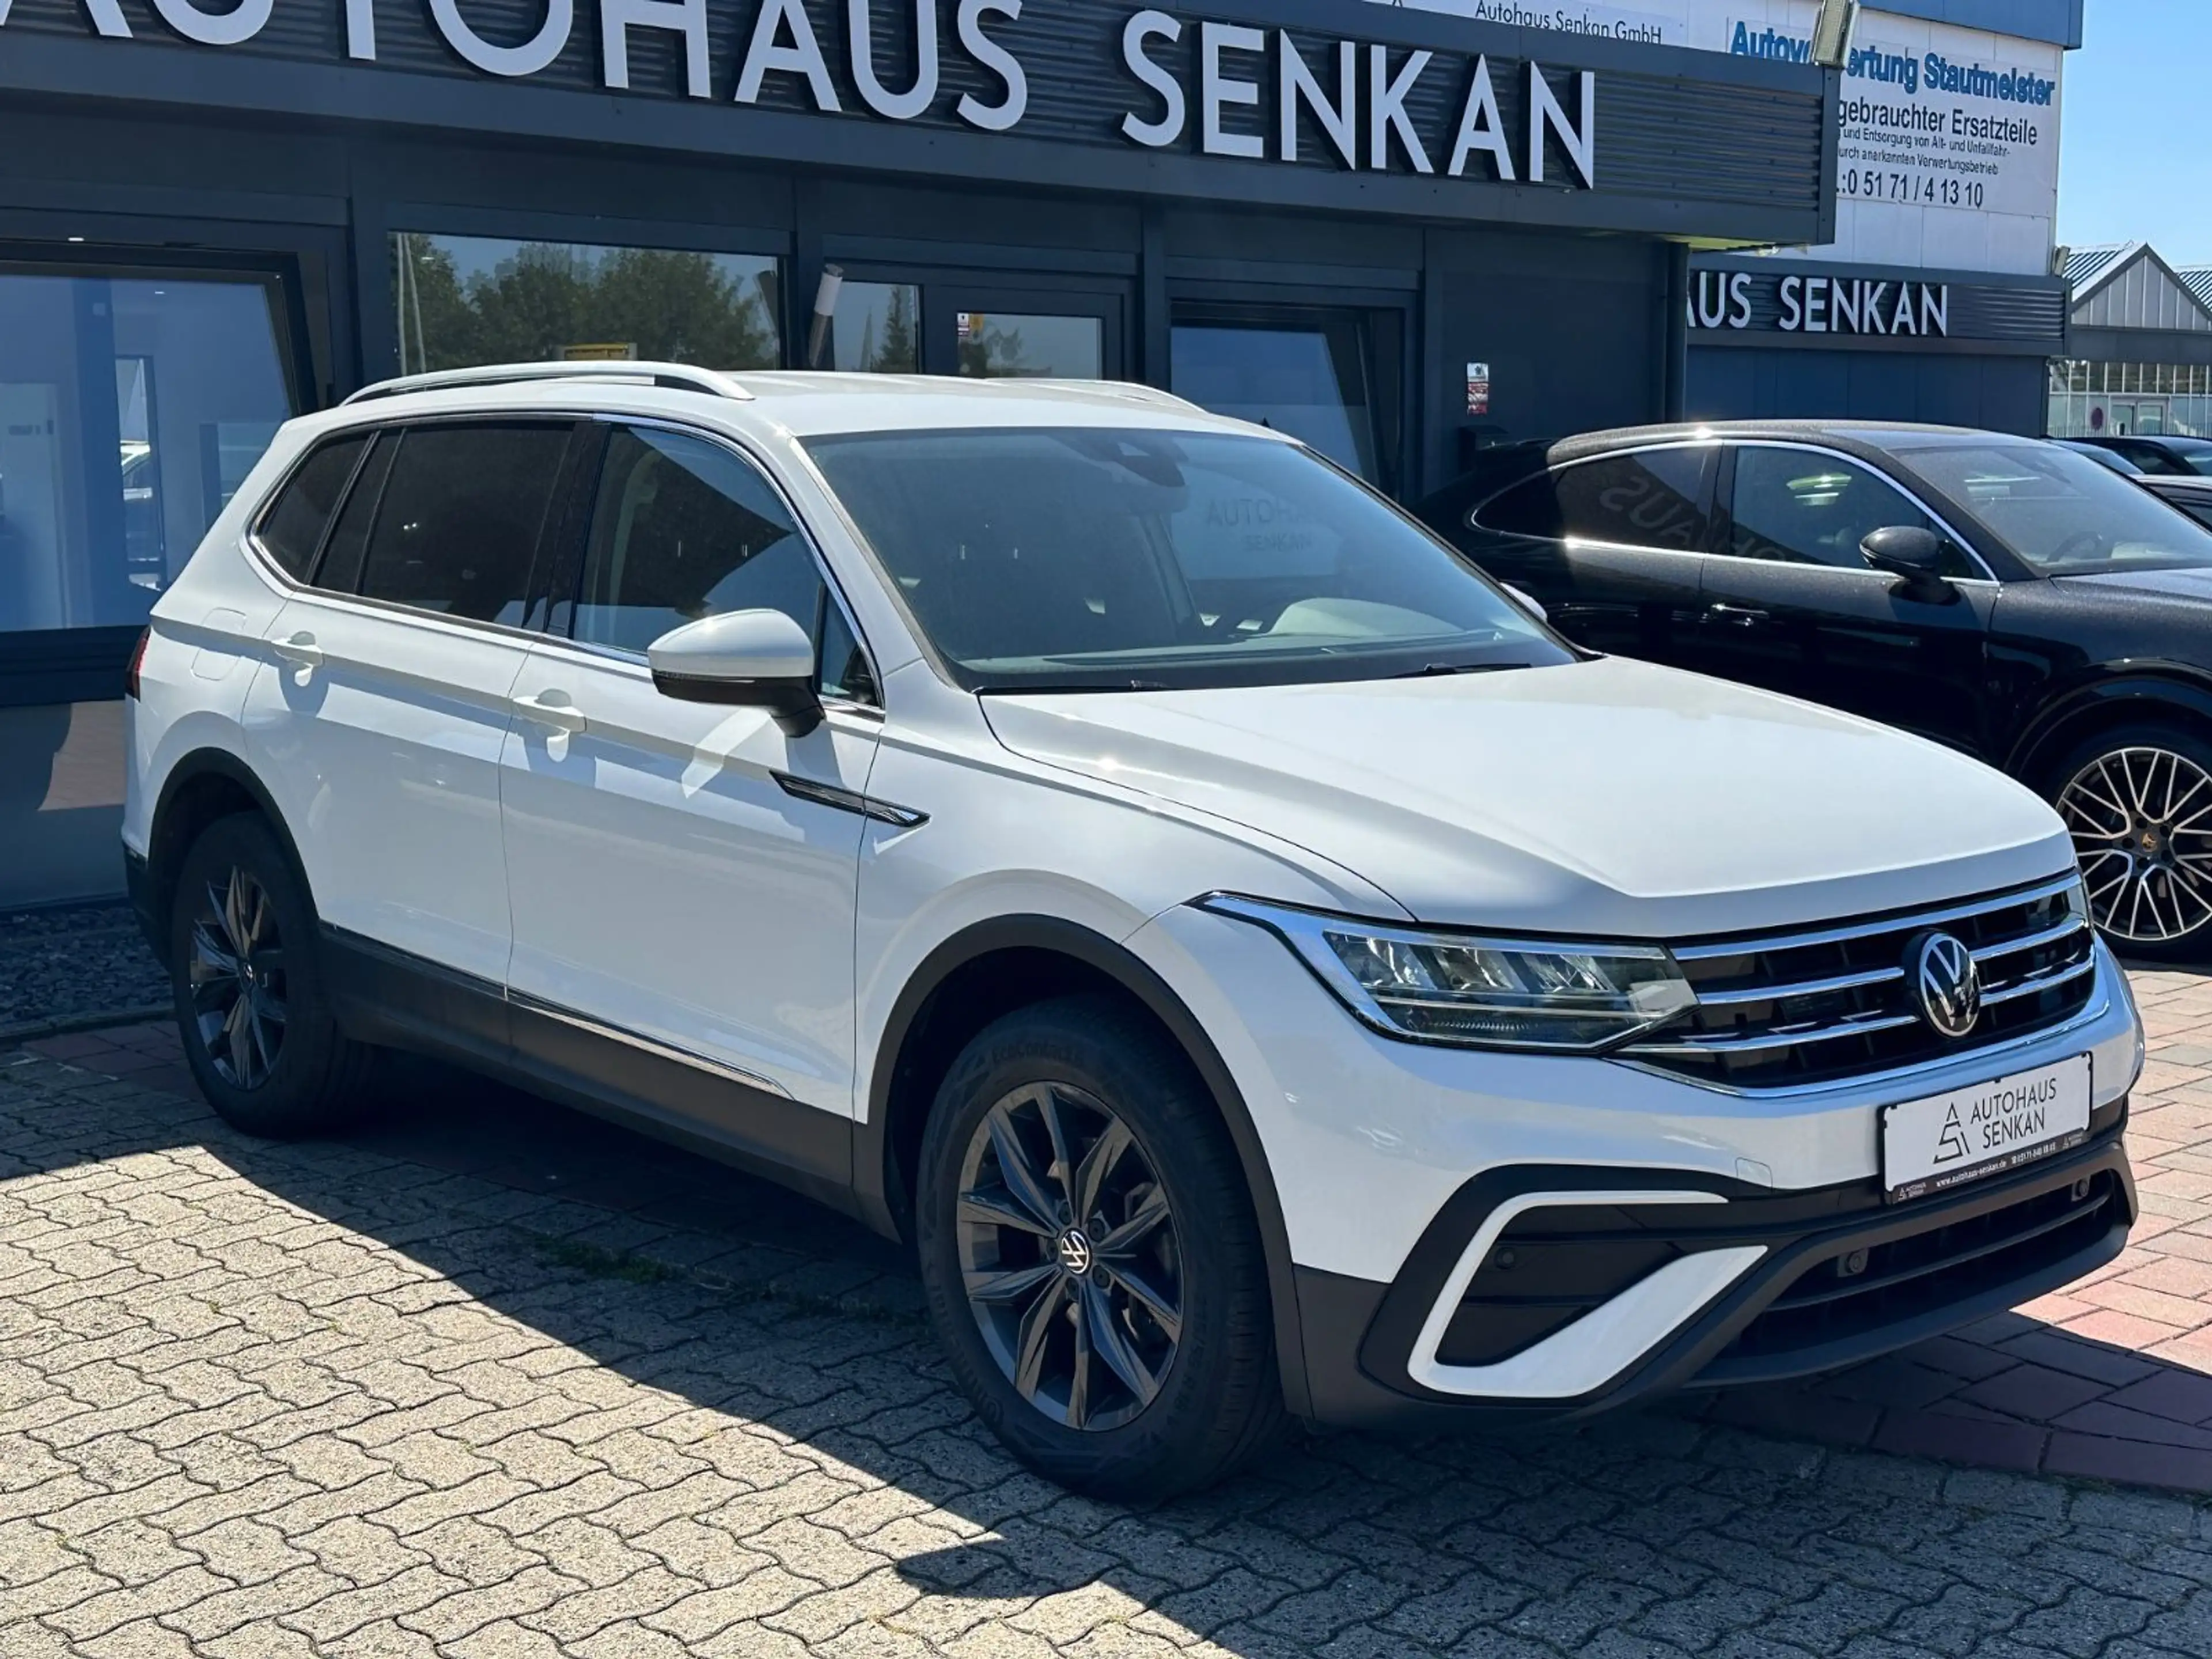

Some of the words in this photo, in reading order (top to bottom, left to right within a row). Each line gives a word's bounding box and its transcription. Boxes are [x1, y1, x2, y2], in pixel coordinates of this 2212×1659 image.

[1475, 1, 1551, 29] Autohaus
[1555, 10, 1610, 37] Senkan
[1614, 20, 1662, 44] GmbH
[0, 0, 1027, 131] OHAUS
[1122, 10, 1595, 190] SENKAN
[1838, 96, 1945, 132] gebrauchter
[1952, 109, 2037, 145] Ersatzteile
[1843, 127, 1861, 140] und
[1863, 128, 1912, 149] Entsorgung
[1914, 136, 1930, 147] von
[1949, 140, 1965, 152] und
[1863, 171, 1882, 197] 51
[1890, 173, 1908, 200] 71
[1925, 177, 1934, 202] 4
[1941, 179, 1959, 204] 13
[1965, 181, 1983, 209] 10
[1779, 275, 1947, 337] SENKAN
[1970, 1078, 2057, 1124] AUTOHAUS
[1982, 1107, 2045, 1149] SENKAN
